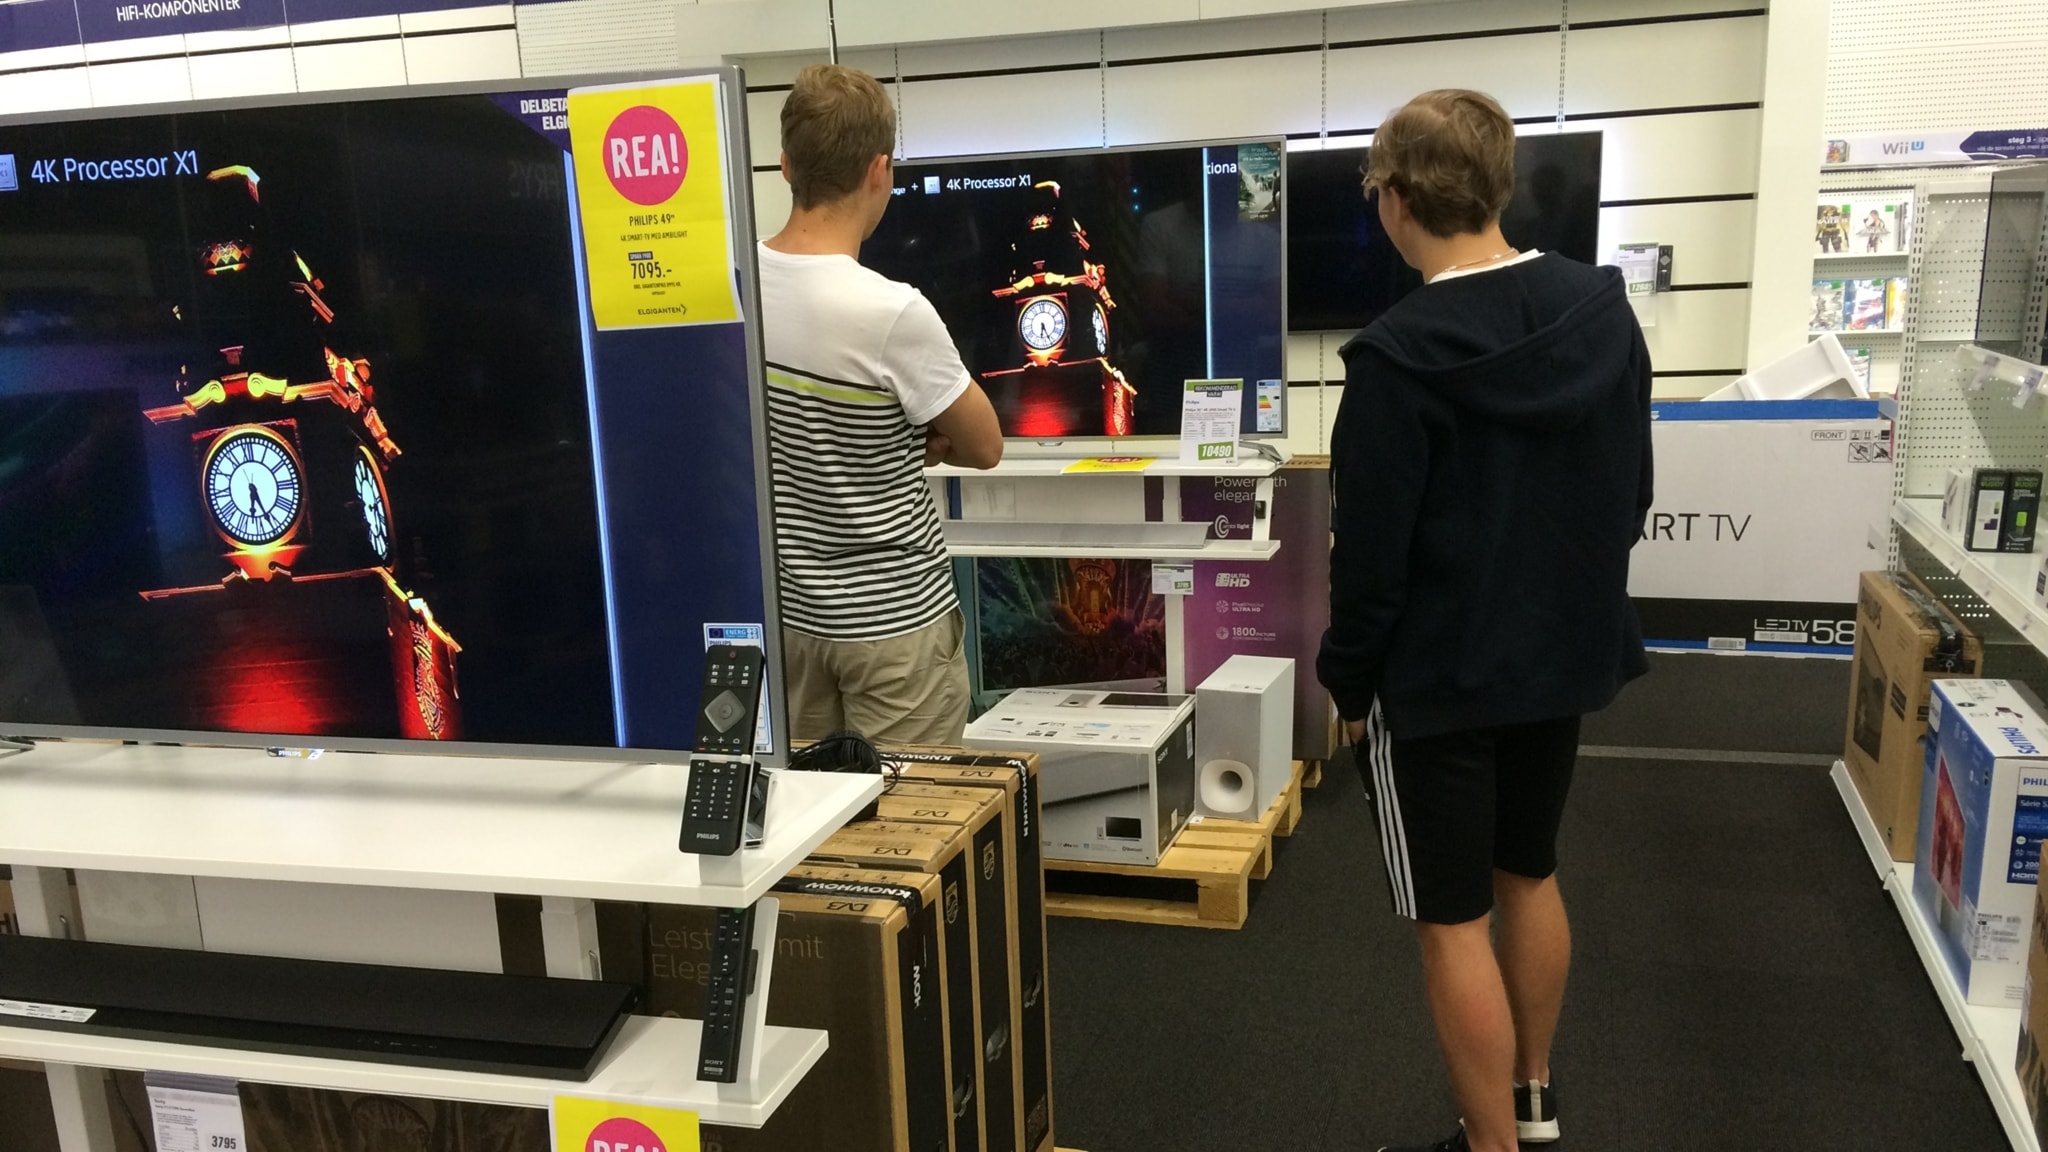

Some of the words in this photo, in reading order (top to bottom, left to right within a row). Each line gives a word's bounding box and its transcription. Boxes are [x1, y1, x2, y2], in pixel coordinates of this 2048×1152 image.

[116, 0, 241, 22] HIFI-KOMPONENTER
[610, 132, 680, 179] REA!
[1882, 142, 1909, 155] Wii
[31, 160, 59, 184] 4K
[63, 157, 169, 182] Processor
[173, 150, 199, 176] X1
[946, 178, 962, 191] 4K
[963, 176, 1017, 190] Processor
[1018, 174, 1032, 187] X1
[629, 214, 659, 226] PHILIPS
[662, 230, 688, 239] AMBILIGHT
[638, 307, 681, 315] ELGIGANTEN
[1201, 445, 1232, 458] 10490
[1214, 475, 1256, 488] Power
[1708, 513, 1752, 542] TV
[1229, 579, 1251, 588] HD
[1232, 627, 1257, 637] 1800
[1754, 619, 1790, 631] LED
[1791, 620, 1810, 631] TV
[1811, 619, 1857, 646] 58
[1997, 726, 2041, 755] PHILIPS
[696, 832, 720, 840] PHILIPS
[805, 882, 912, 899] KNOWHOW
[778, 935, 825, 960] mit
[211, 1135, 237, 1150] 3795
